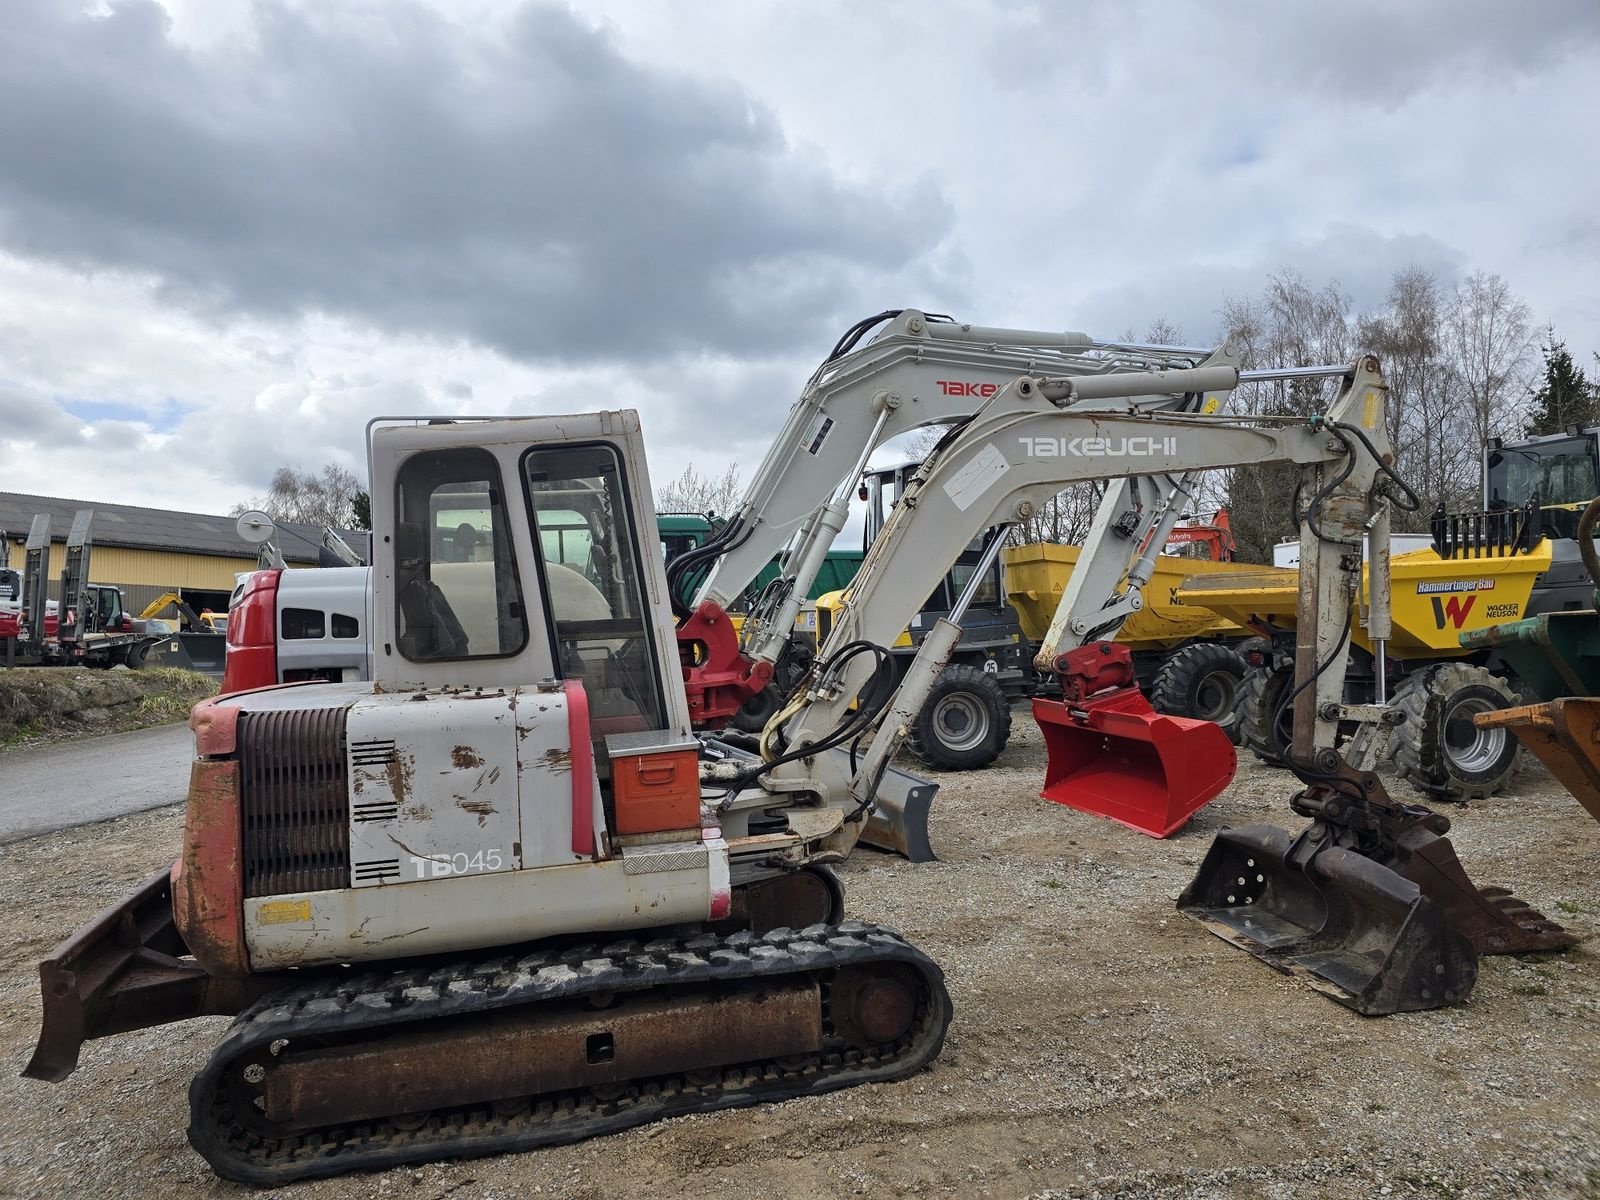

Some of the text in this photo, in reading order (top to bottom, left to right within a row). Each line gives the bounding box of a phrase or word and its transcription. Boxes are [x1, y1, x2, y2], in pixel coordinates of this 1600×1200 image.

[1018, 437, 1177, 457] TAKEUCHI
[1417, 578, 1494, 593] Hammertinger Bau
[1487, 603, 1519, 611] WACKER
[1486, 610, 1519, 618] NEUSON
[986, 662, 995, 673] 25
[410, 848, 502, 879] TB045
